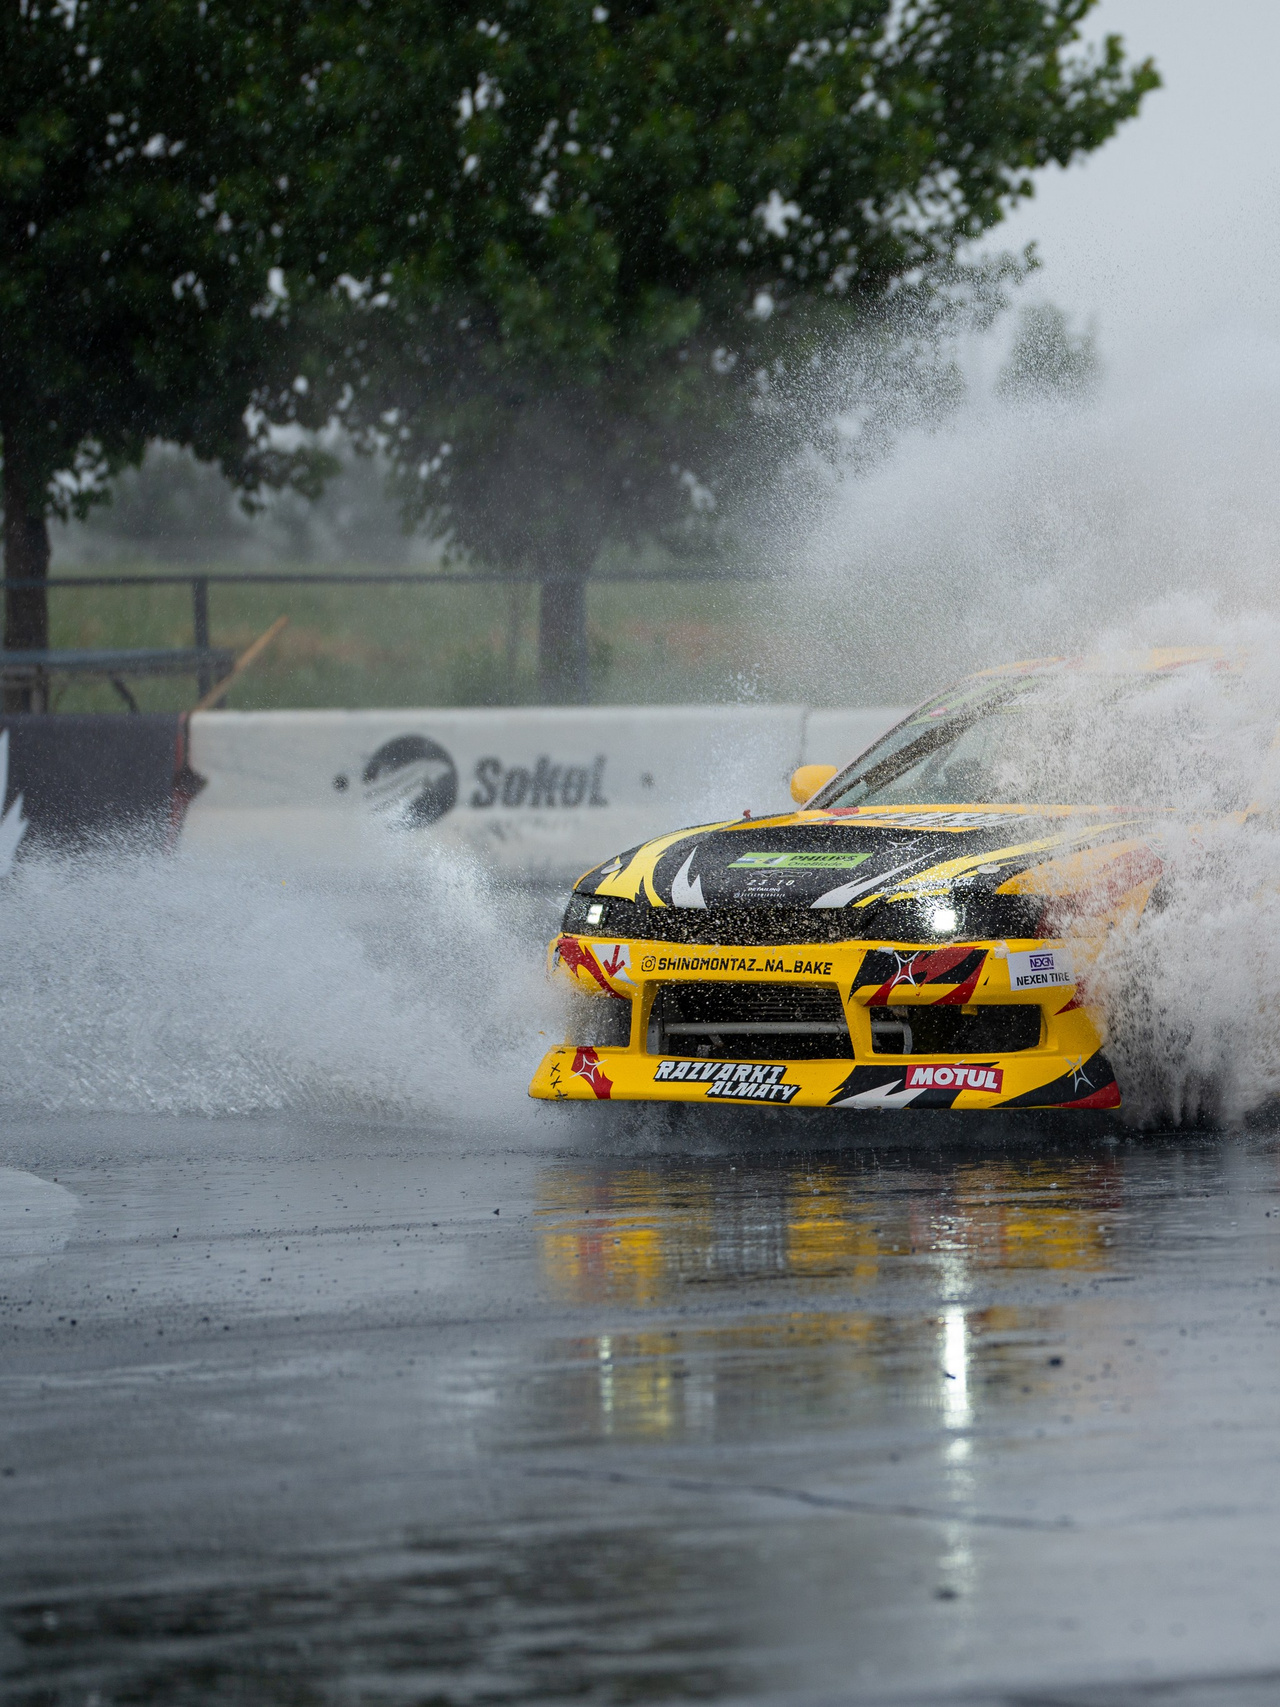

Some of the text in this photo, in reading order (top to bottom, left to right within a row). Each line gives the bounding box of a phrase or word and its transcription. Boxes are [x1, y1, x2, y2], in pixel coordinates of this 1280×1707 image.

[470, 754, 608, 808] Sokol
[658, 957, 833, 976] SHINOMONTAZ_NA_BAKE
[1016, 971, 1070, 986] NEXEN TIRE
[654, 1061, 785, 1084] RAZVARKI
[910, 1067, 998, 1089] MOTUL
[706, 1081, 797, 1101] ALMATY
